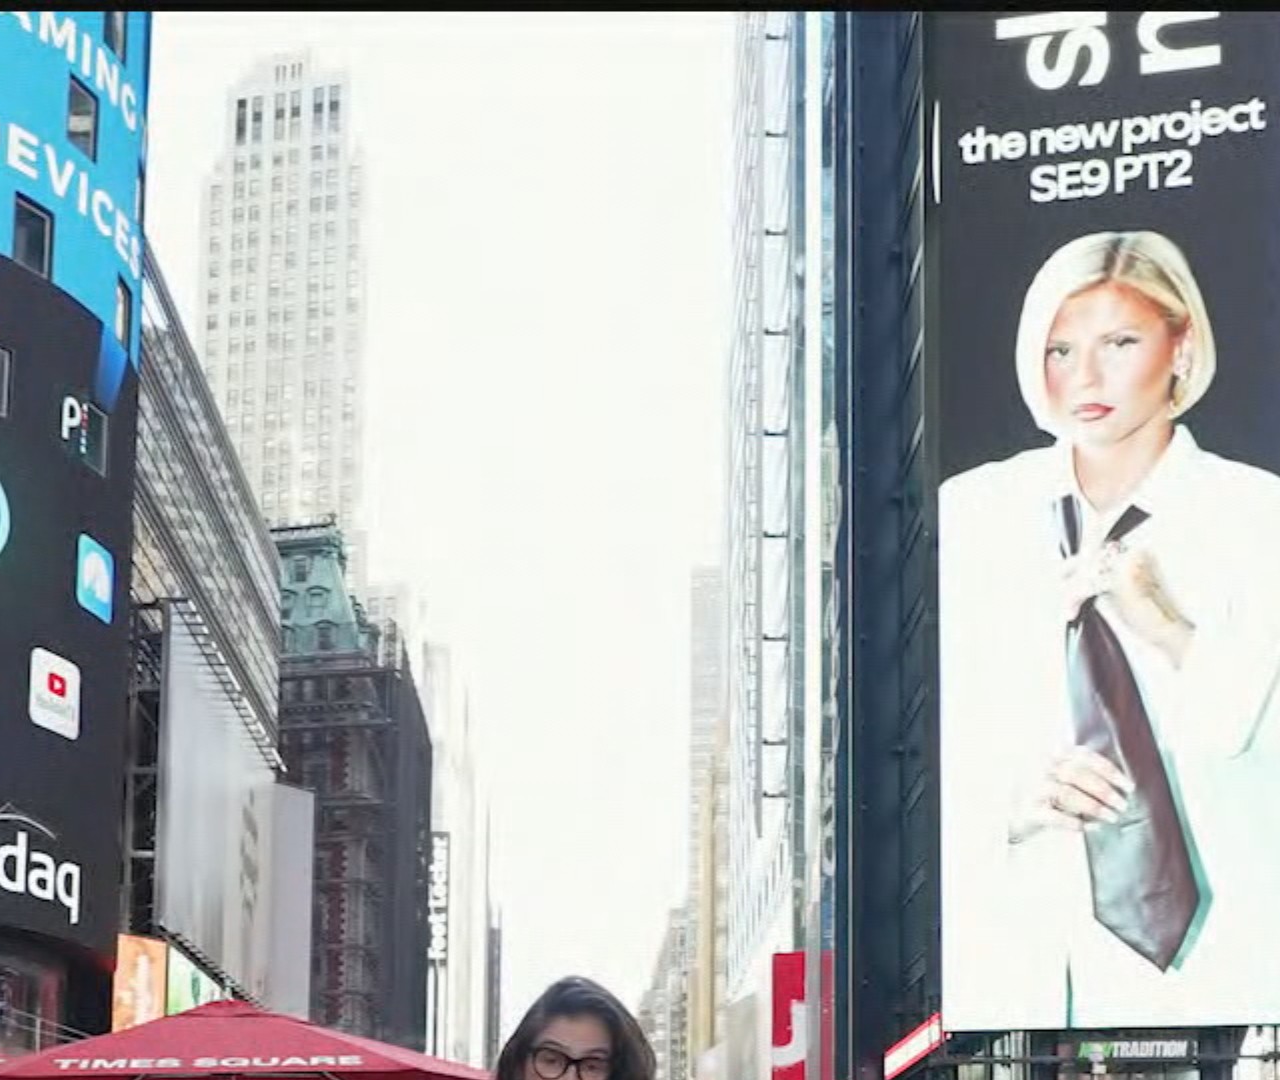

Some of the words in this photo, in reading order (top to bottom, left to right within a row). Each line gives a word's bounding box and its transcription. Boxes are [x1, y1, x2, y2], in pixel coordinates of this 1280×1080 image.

[958, 126, 1026, 164] the
[1030, 118, 1120, 156] new
[1122, 97, 1266, 153] project
[1029, 158, 1110, 203] SE9
[1114, 149, 1193, 193] PT2
[53, 1057, 182, 1070] TIMES
[193, 1054, 363, 1068] SQUARE
